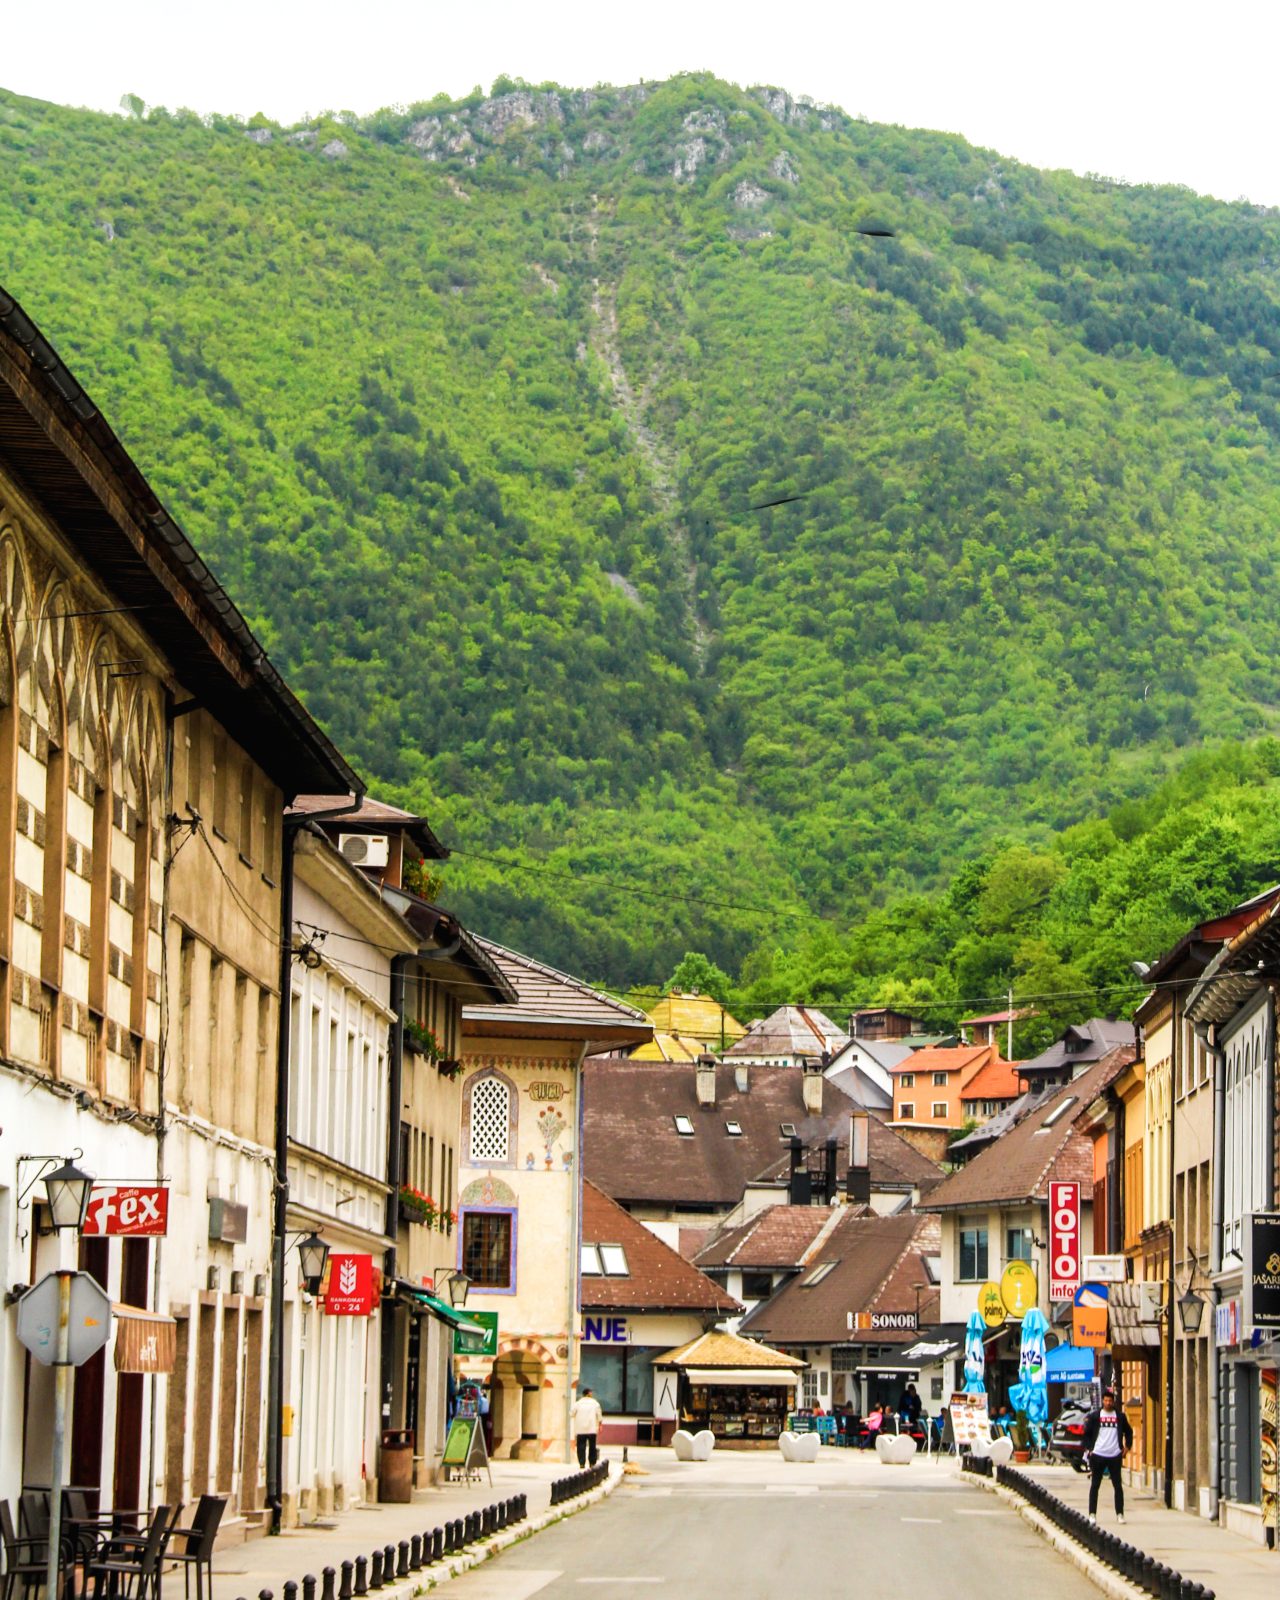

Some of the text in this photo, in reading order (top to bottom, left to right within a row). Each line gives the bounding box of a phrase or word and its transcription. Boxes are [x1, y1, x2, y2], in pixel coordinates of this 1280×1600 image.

[118, 1188, 140, 1199] caffe
[88, 1187, 161, 1236] Fex
[1054, 1186, 1077, 1278] FOTO
[334, 1303, 341, 1312] 0
[348, 1303, 361, 1312] 24
[581, 1317, 627, 1342] NJE
[872, 1314, 915, 1328] SONOR
